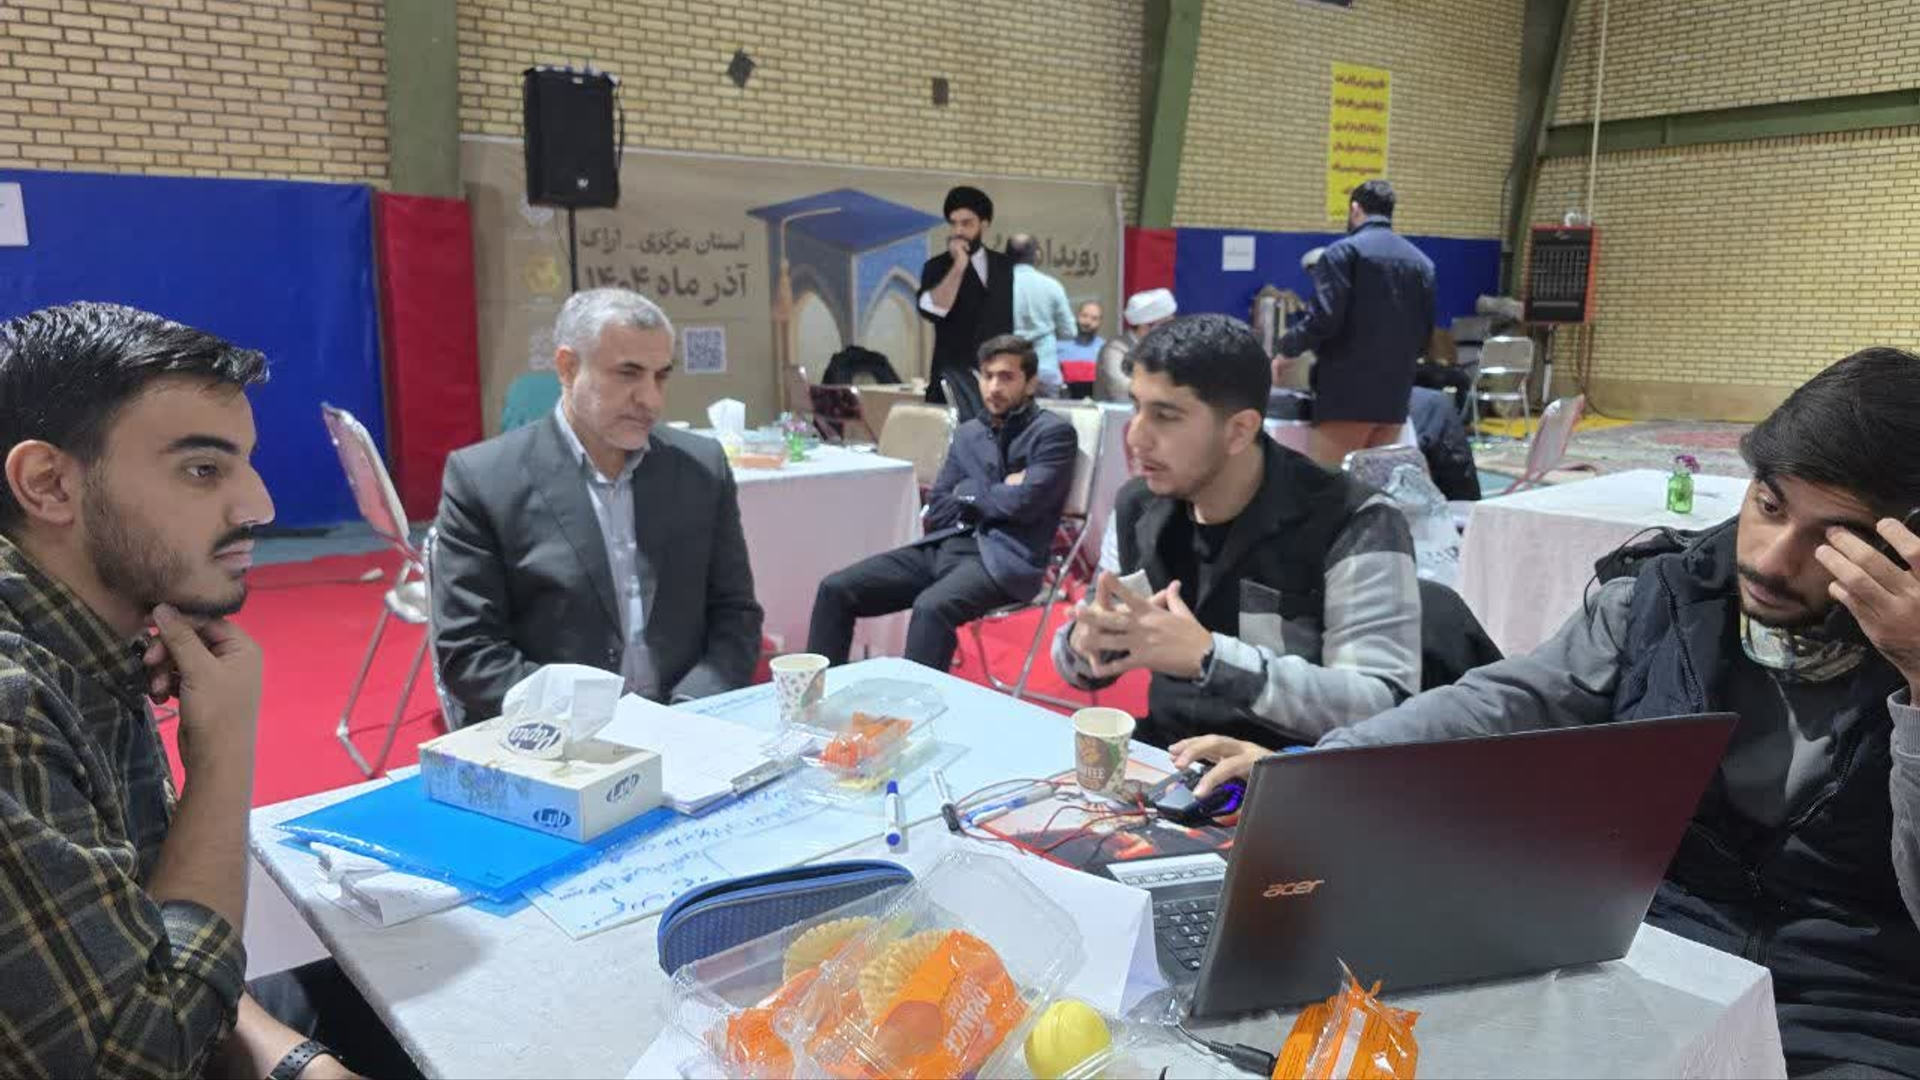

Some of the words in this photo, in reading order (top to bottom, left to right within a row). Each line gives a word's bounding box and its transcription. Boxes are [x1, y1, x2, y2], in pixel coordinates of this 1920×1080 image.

[580, 226, 621, 254] اراک
[639, 228, 690, 254] مرکزی
[696, 229, 745, 254] استان
[657, 267, 699, 296] ماه
[704, 263, 748, 305] آذر
[1263, 878, 1325, 898] acer
[944, 984, 991, 1056] ORANGE
